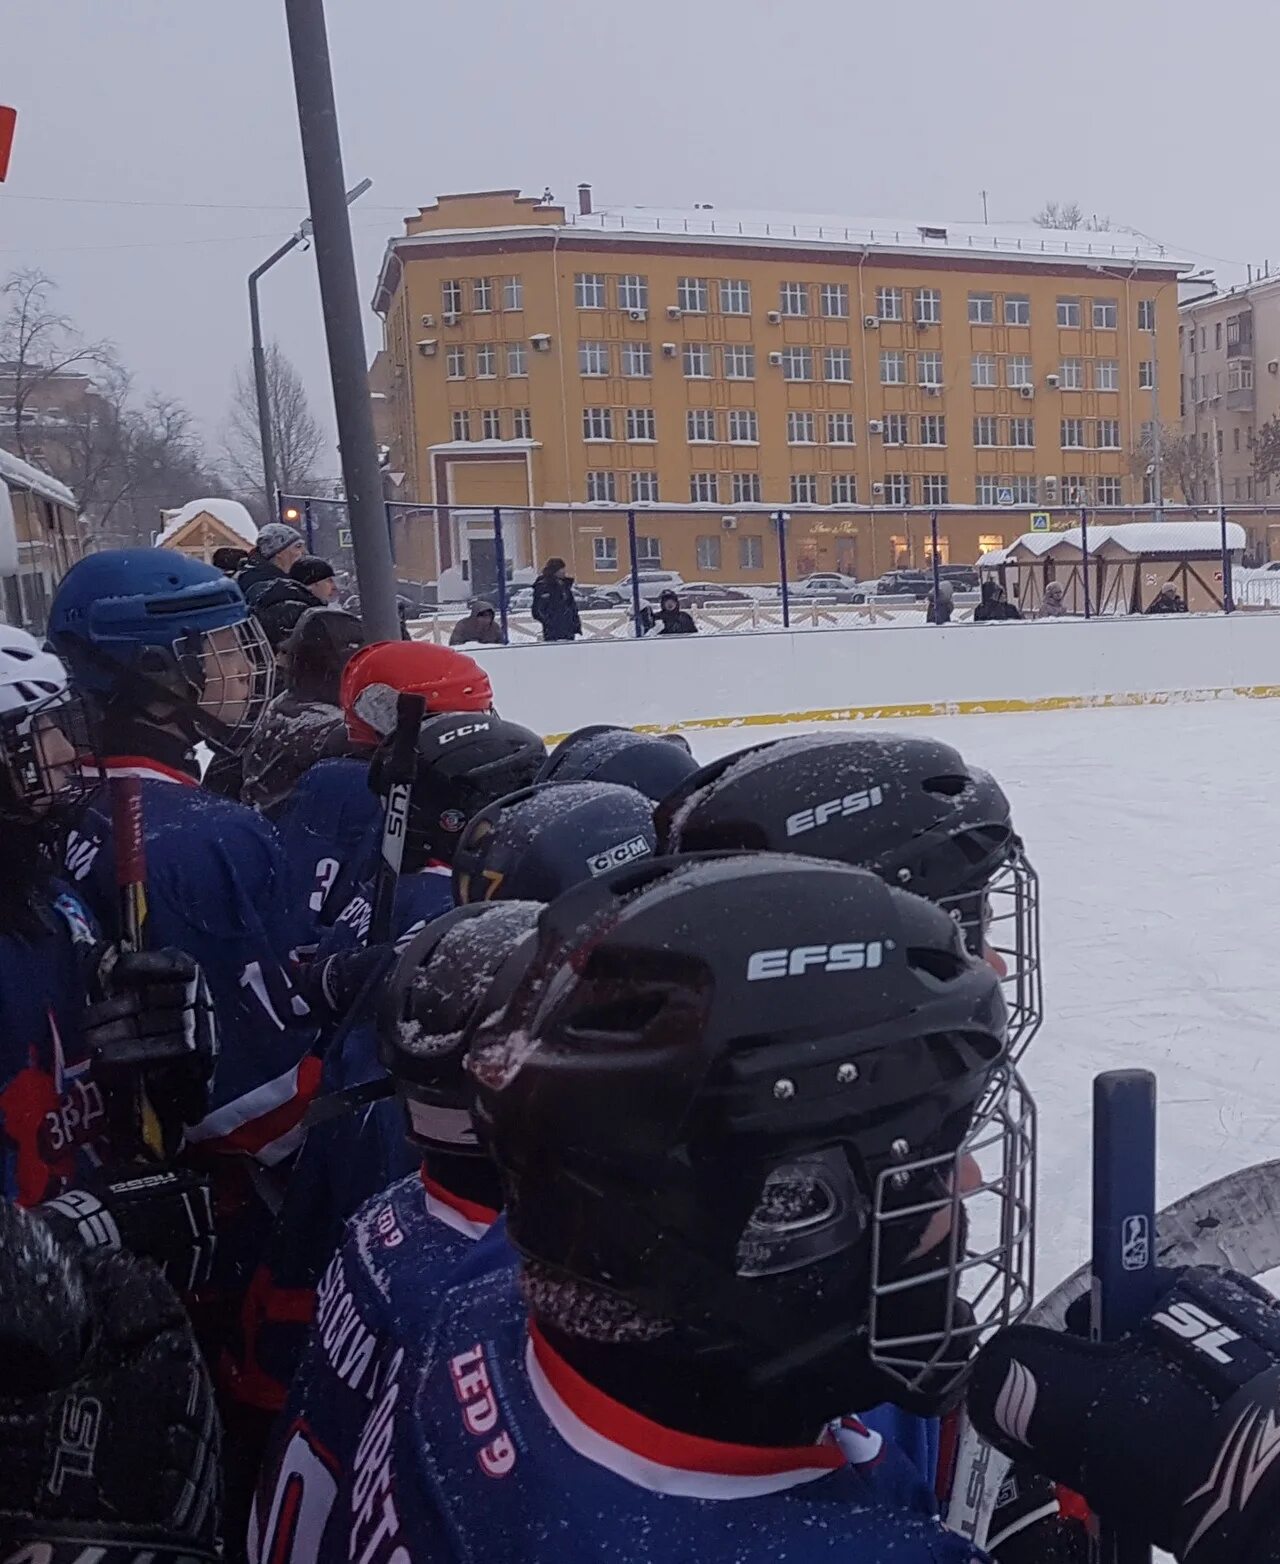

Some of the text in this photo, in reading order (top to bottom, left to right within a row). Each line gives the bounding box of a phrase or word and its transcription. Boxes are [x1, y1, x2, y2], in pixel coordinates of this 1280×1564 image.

[438, 722, 490, 745] CCM
[786, 786, 884, 837] EFSI
[590, 836, 649, 873] CCM
[746, 941, 883, 982] EFSI
[1152, 1300, 1241, 1366] SL
[450, 1343, 499, 1437] LED
[475, 1431, 518, 1481] 9
